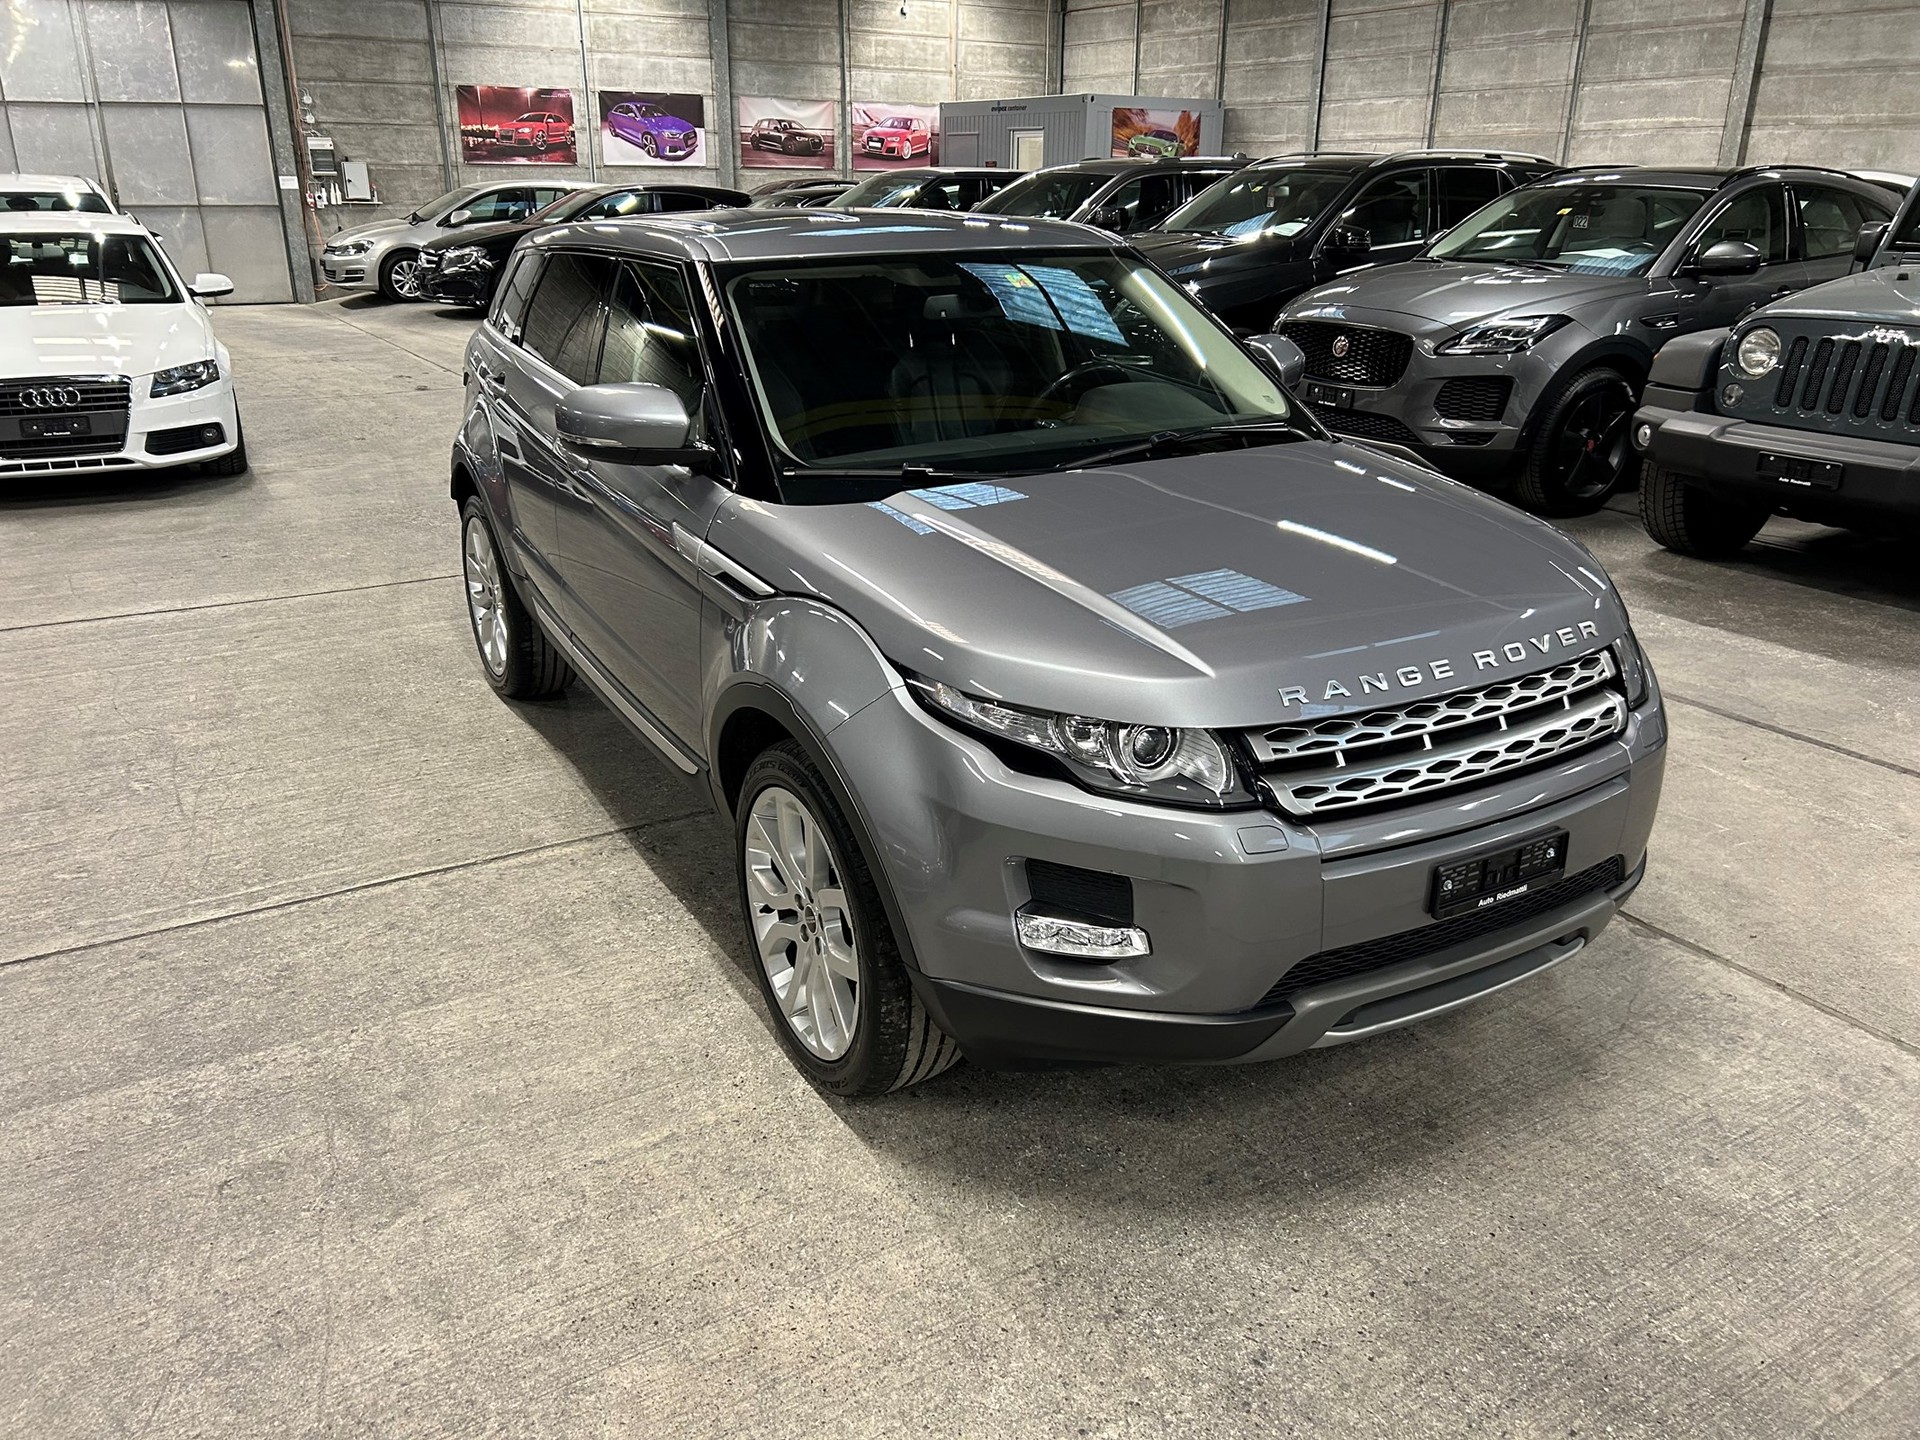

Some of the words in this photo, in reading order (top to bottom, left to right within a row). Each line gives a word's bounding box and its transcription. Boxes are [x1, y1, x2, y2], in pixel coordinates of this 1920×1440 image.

[1277, 658, 1454, 707] RANGE
[1472, 620, 1599, 670] ROVER
[1477, 897, 1494, 907] Auto
